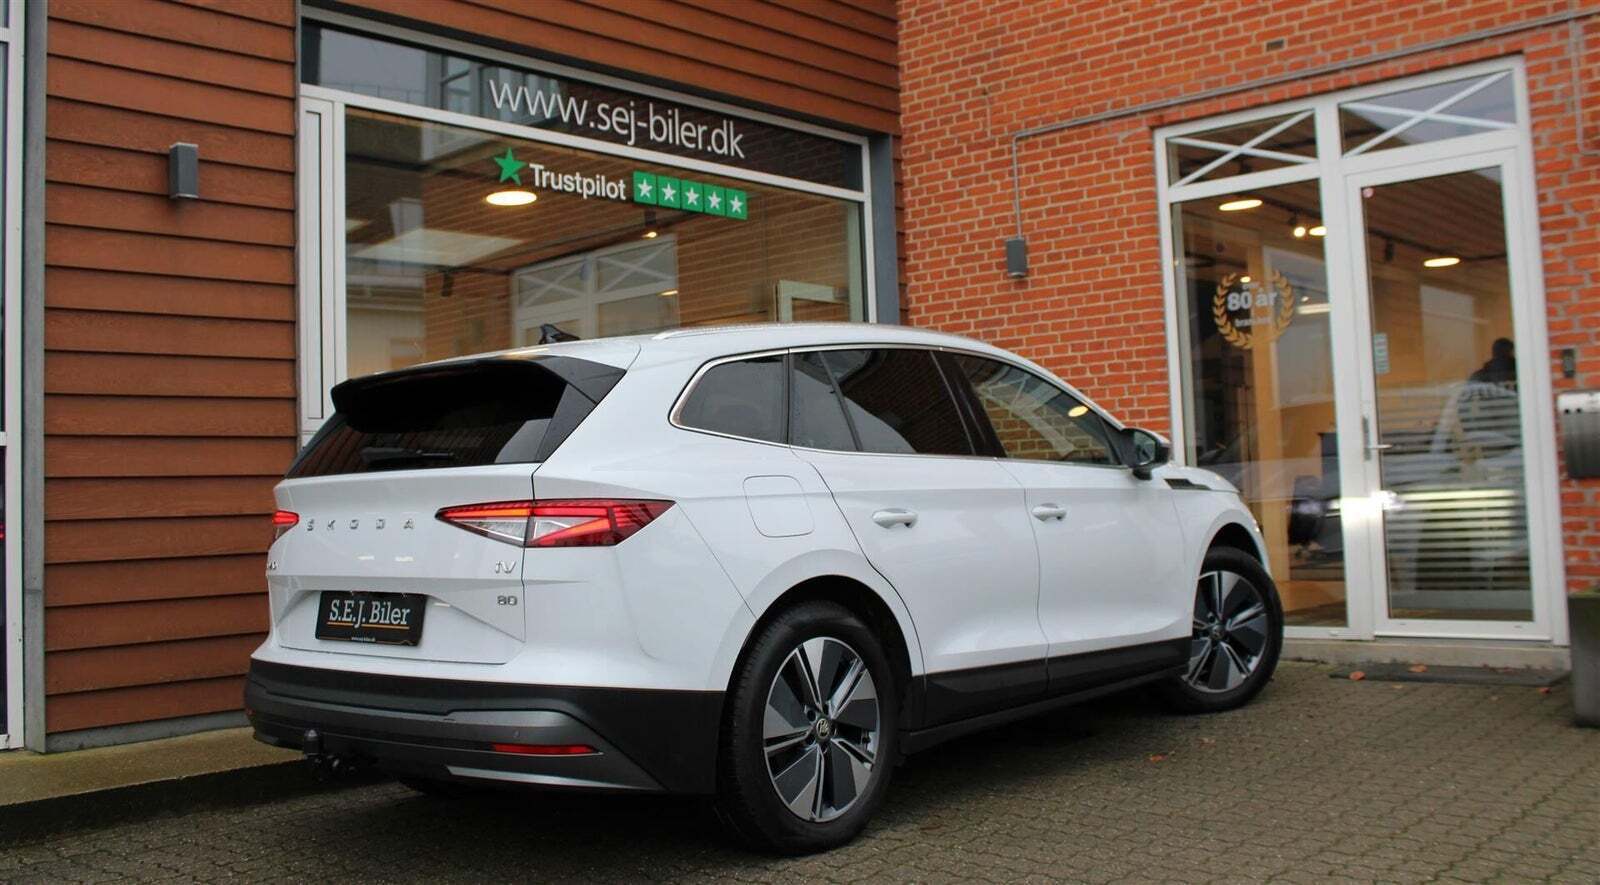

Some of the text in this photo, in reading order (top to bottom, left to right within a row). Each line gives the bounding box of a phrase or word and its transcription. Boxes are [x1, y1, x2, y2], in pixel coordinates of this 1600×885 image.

[489, 79, 745, 159] www.sej-biler.dk
[529, 163, 627, 201] Trustpilot
[1227, 291, 1252, 311] 80
[329, 599, 410, 628] S.E.J. Biler
[497, 595, 518, 606] 80
